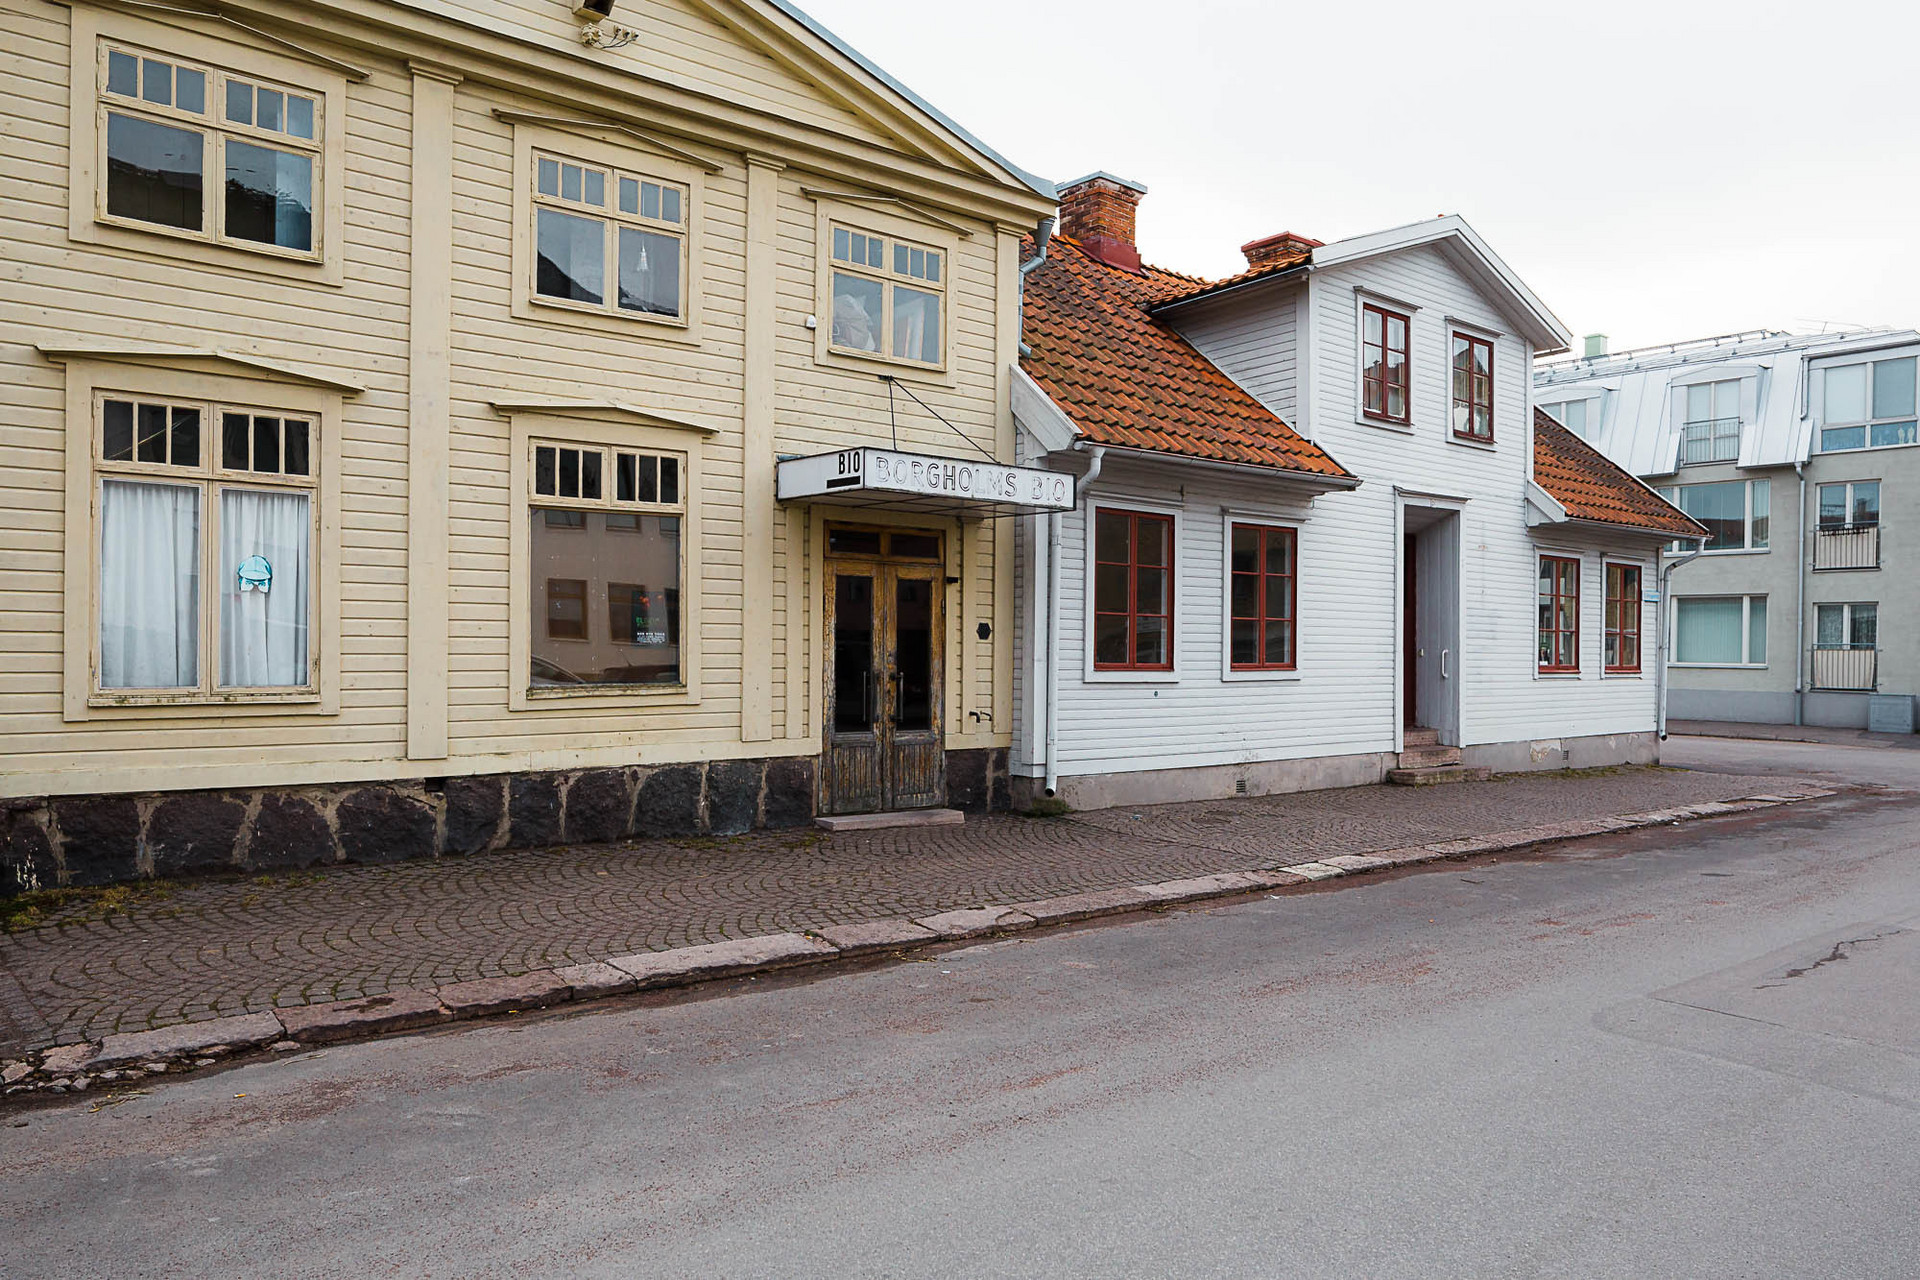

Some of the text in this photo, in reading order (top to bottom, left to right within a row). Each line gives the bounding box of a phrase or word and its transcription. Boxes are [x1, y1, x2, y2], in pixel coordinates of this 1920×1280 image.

[839, 451, 860, 475] BIO
[876, 456, 1065, 502] BORGHOLMS BIO
